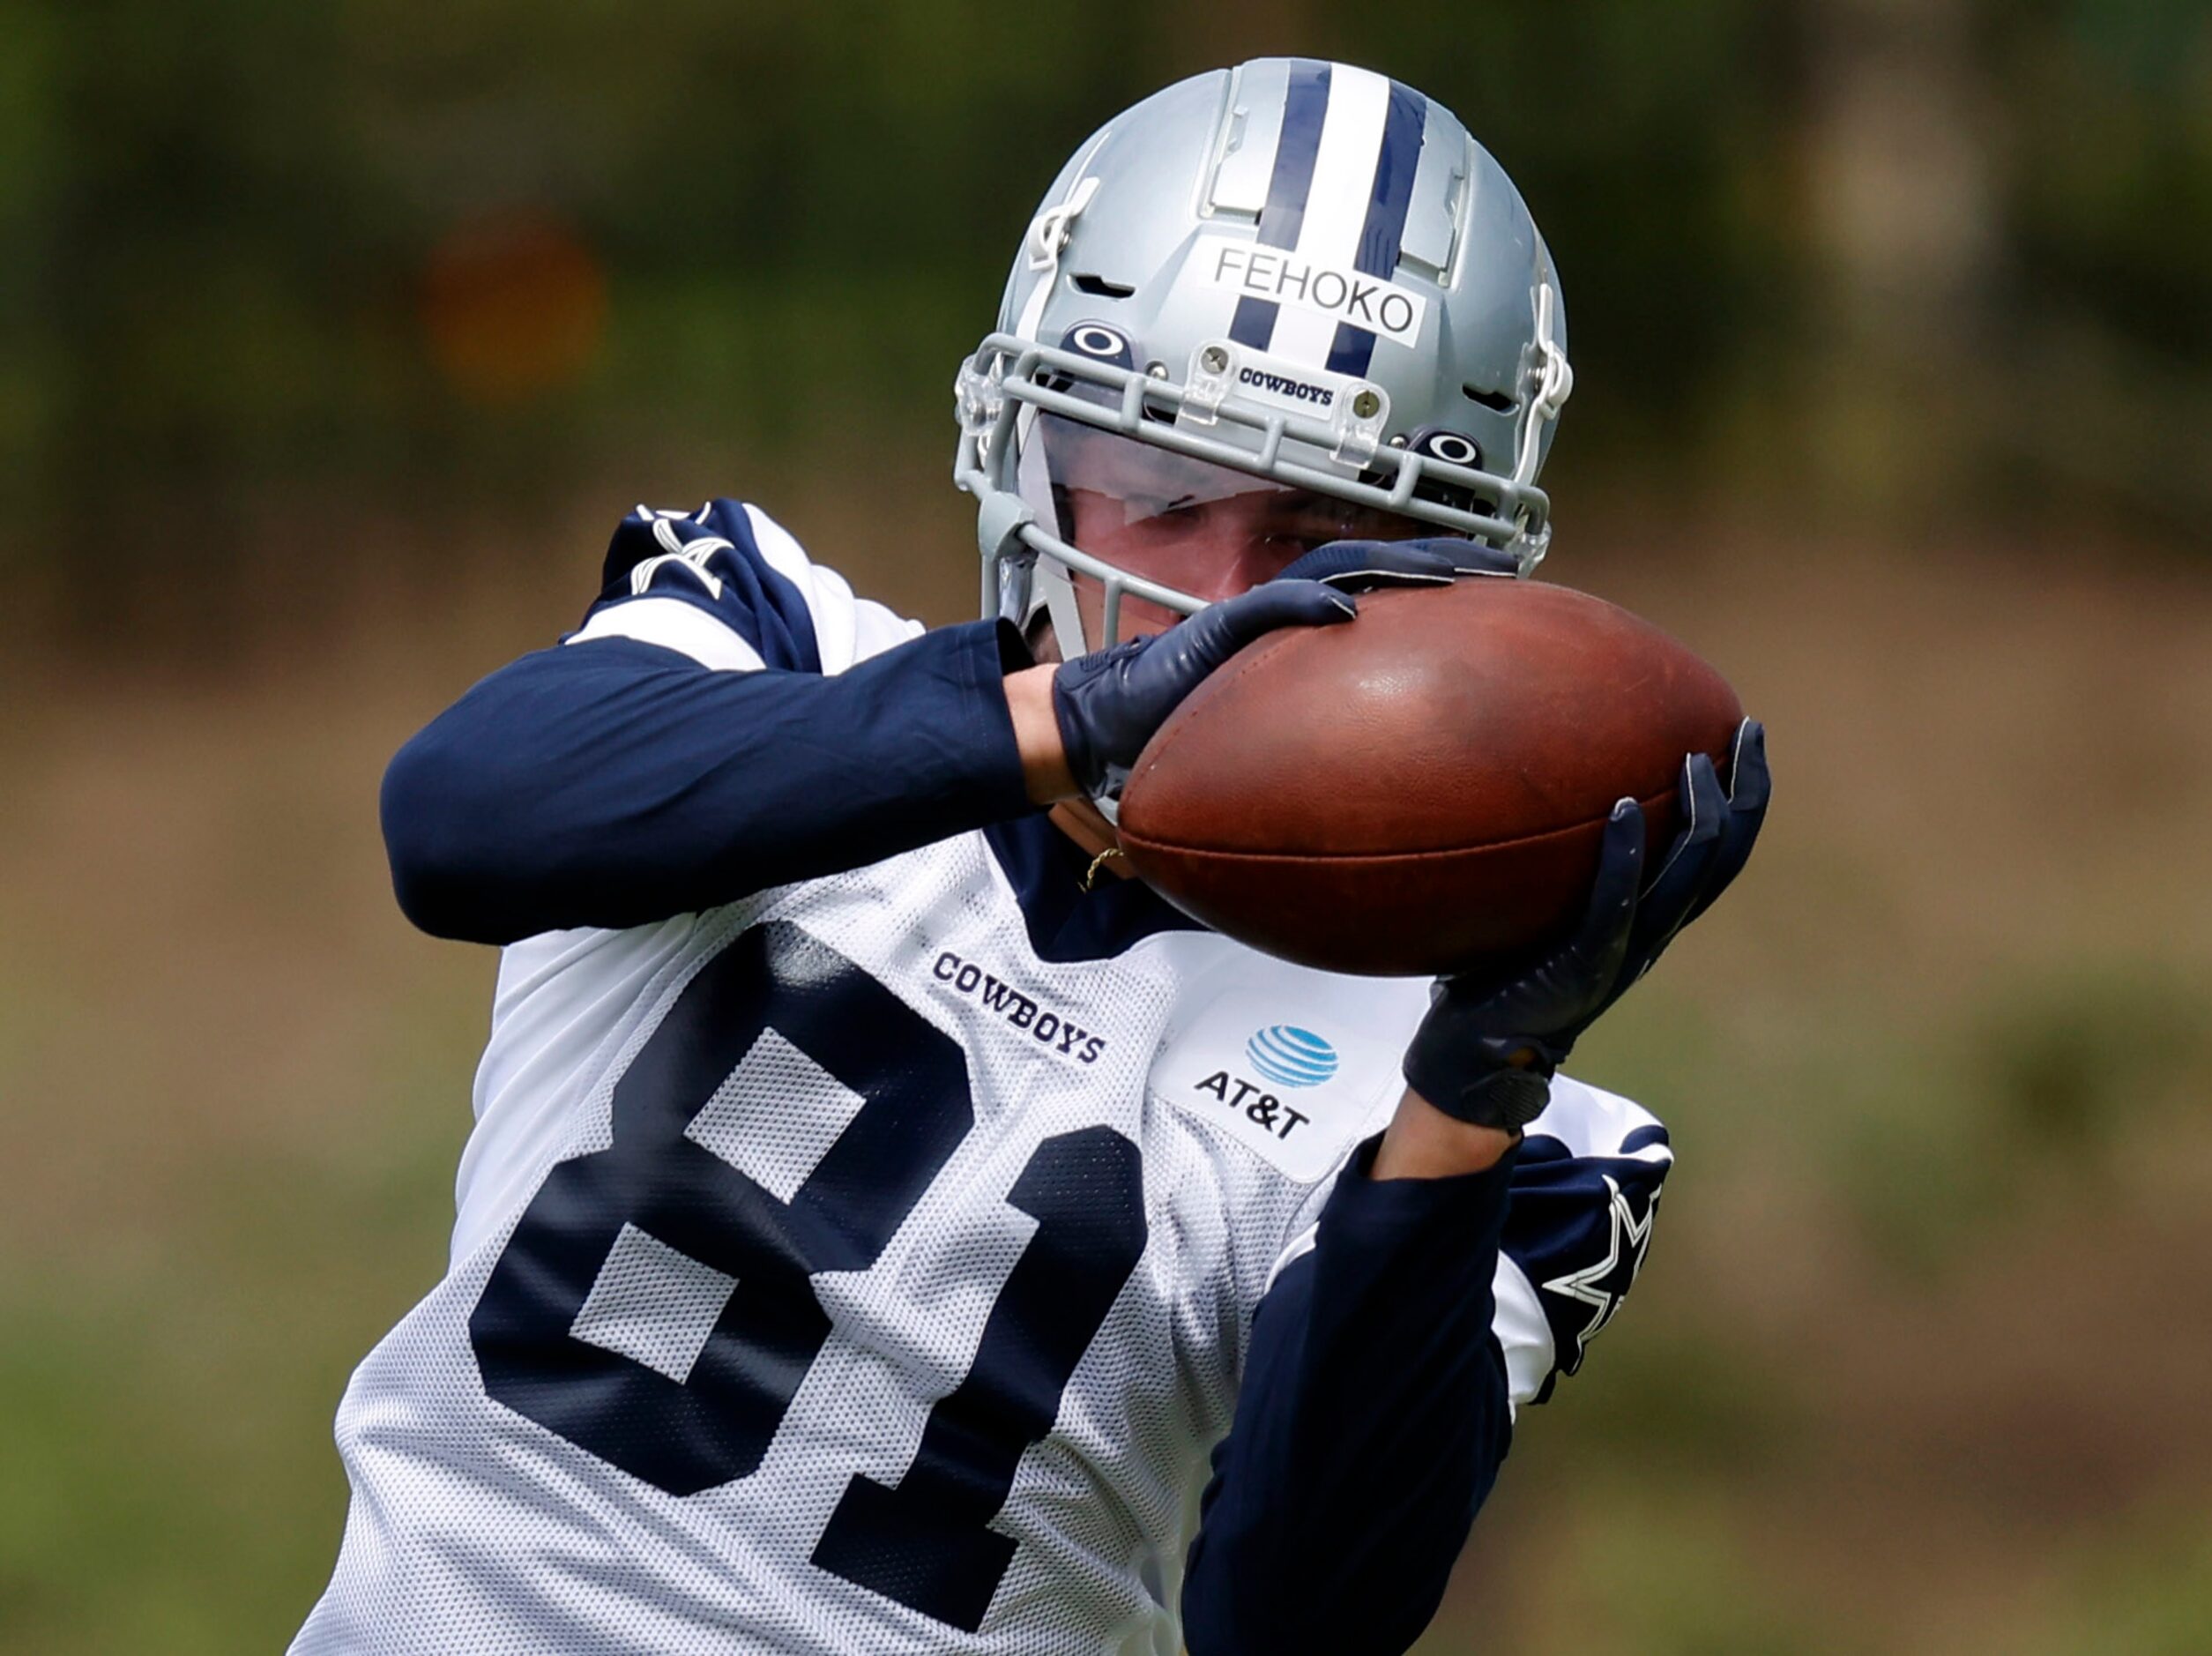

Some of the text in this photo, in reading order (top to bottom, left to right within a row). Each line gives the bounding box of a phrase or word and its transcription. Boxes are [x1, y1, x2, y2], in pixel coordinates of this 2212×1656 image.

[1214, 247, 1415, 333] FEHOKO
[1239, 367, 1334, 407] COWBOYS
[933, 951, 1106, 1064] COWBOYS
[1195, 1070, 1310, 1140] AT&T
[468, 920, 1149, 1633] 81
